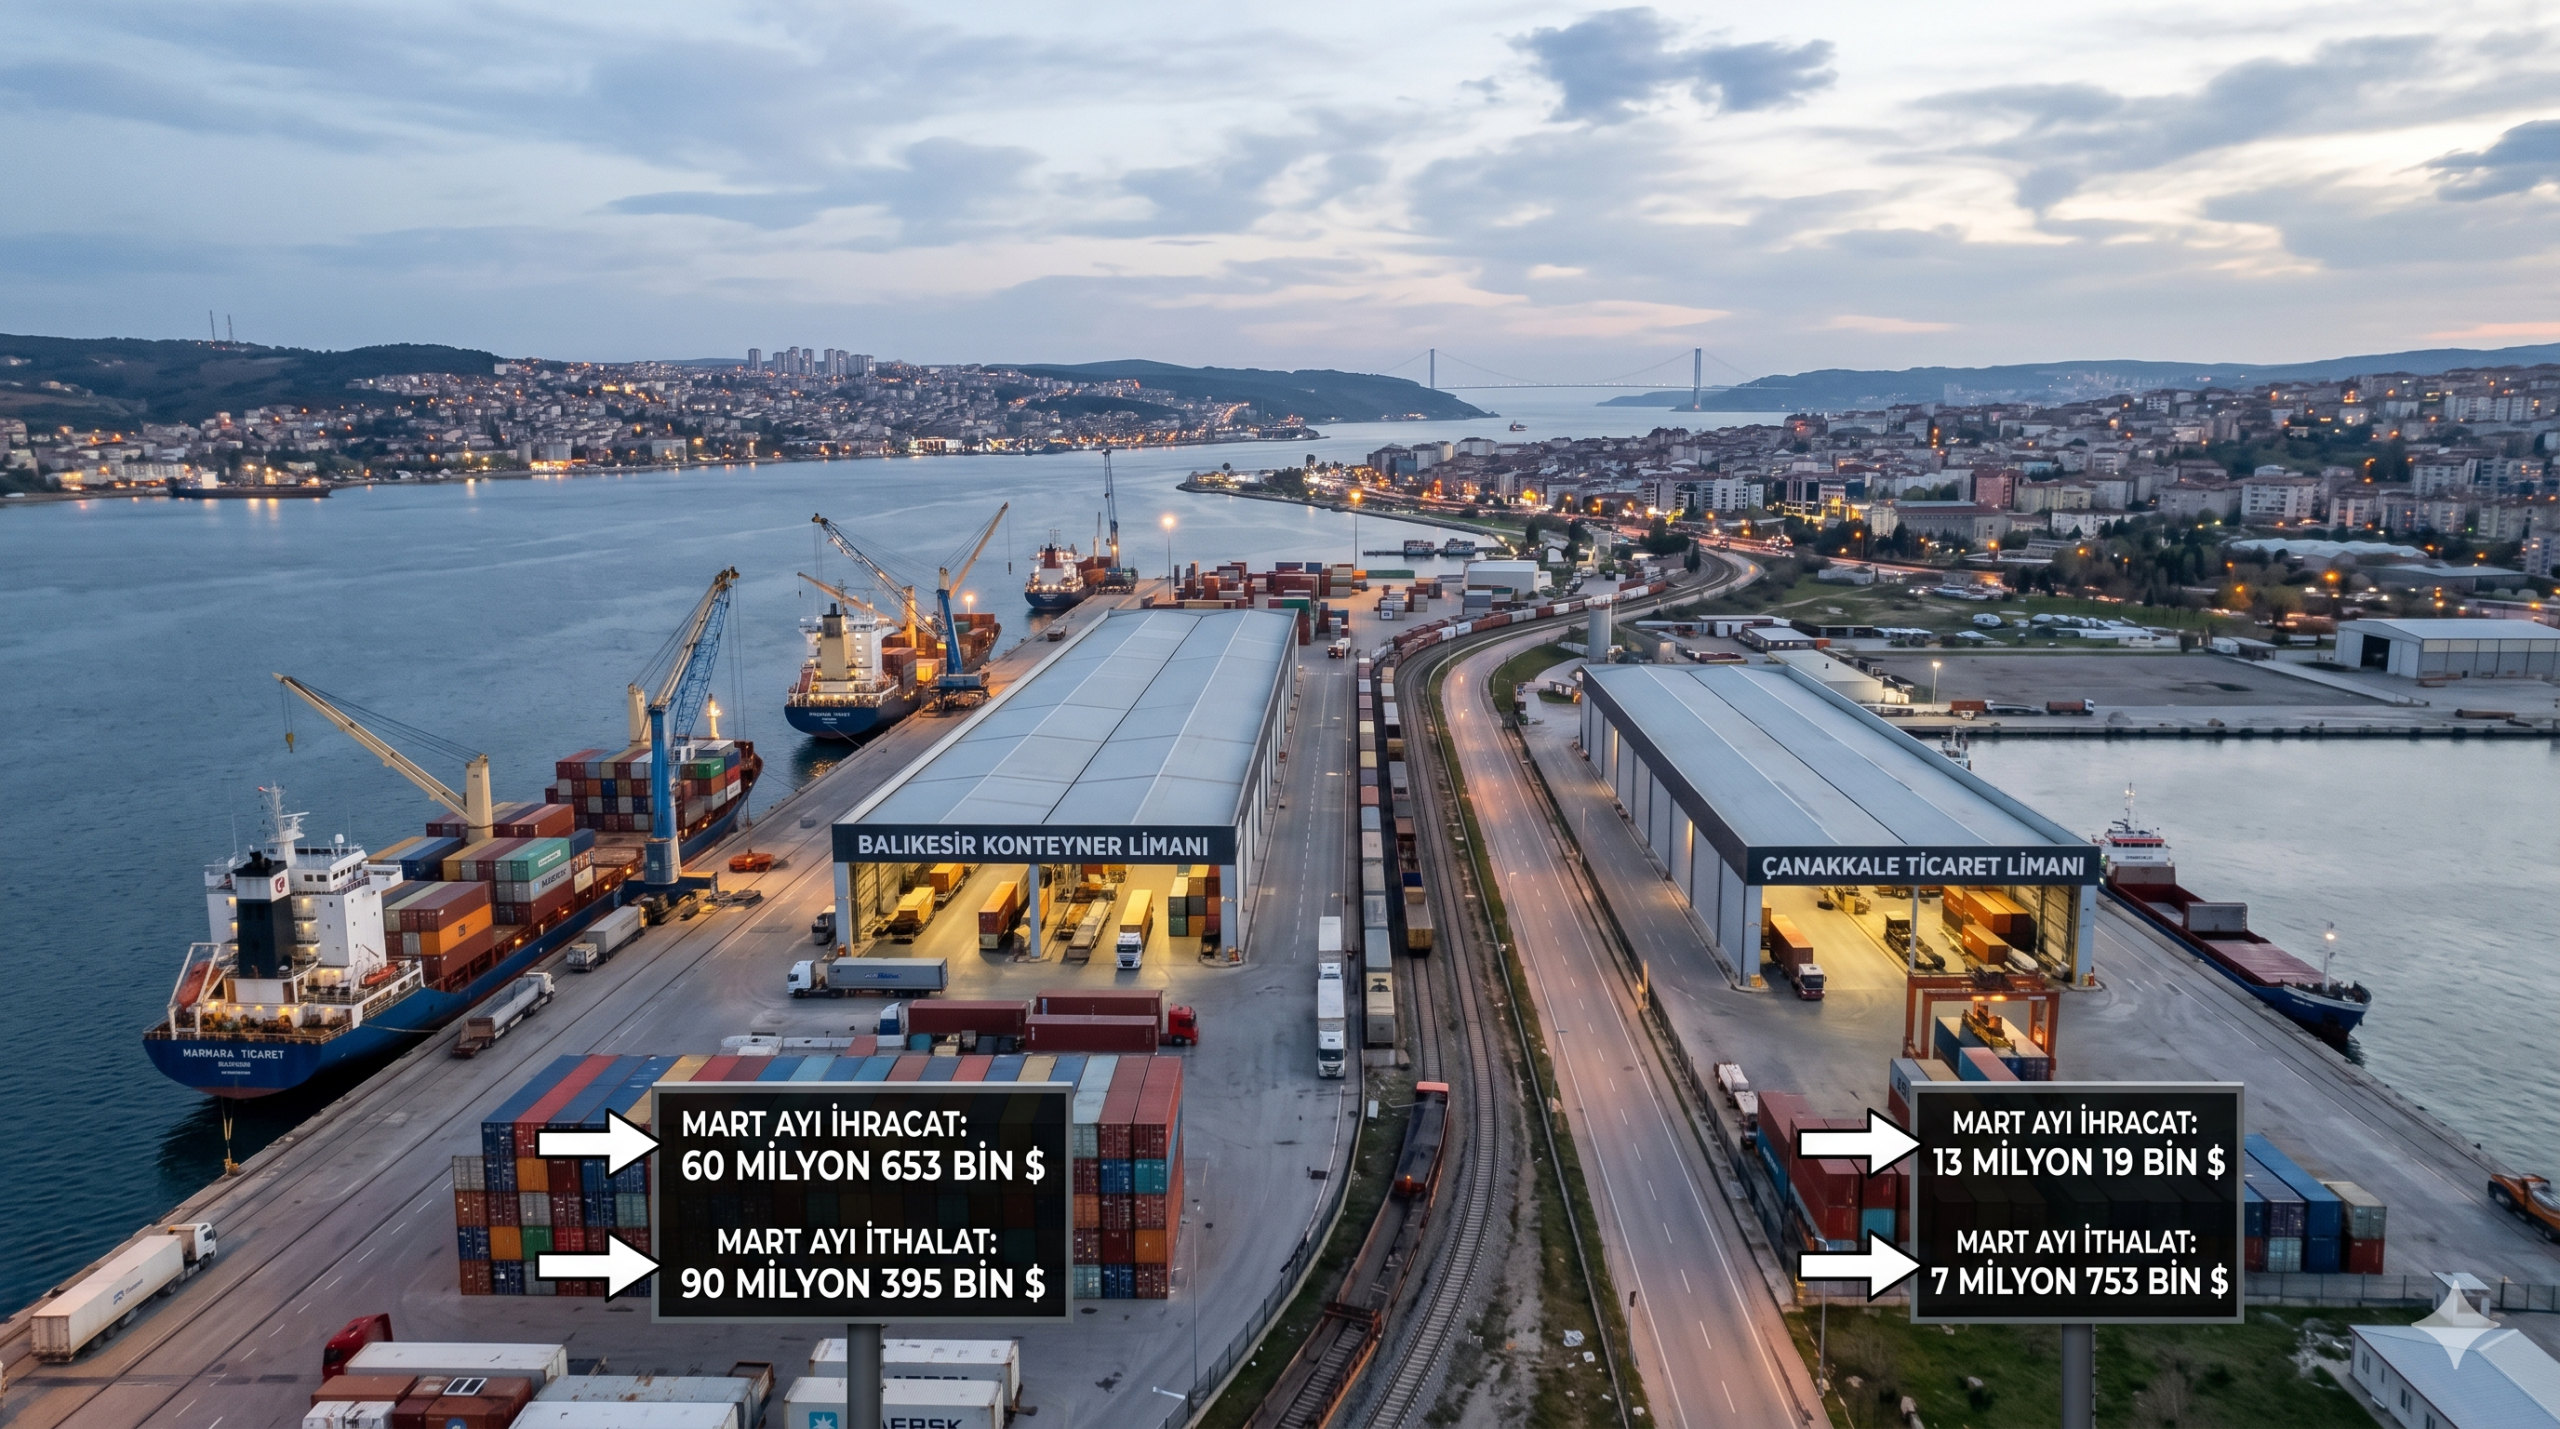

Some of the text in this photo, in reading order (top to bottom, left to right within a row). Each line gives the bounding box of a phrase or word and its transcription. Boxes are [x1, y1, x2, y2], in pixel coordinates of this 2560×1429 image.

[858, 831, 1208, 856] BALIKESİR KONTEYNER LİMANI
[1762, 851, 2085, 880] ÇANAKKALE TİCARET LİMANI
[183, 1048, 284, 1059] MARMARA TICARET
[883, 1418, 962, 1429] ERSK
